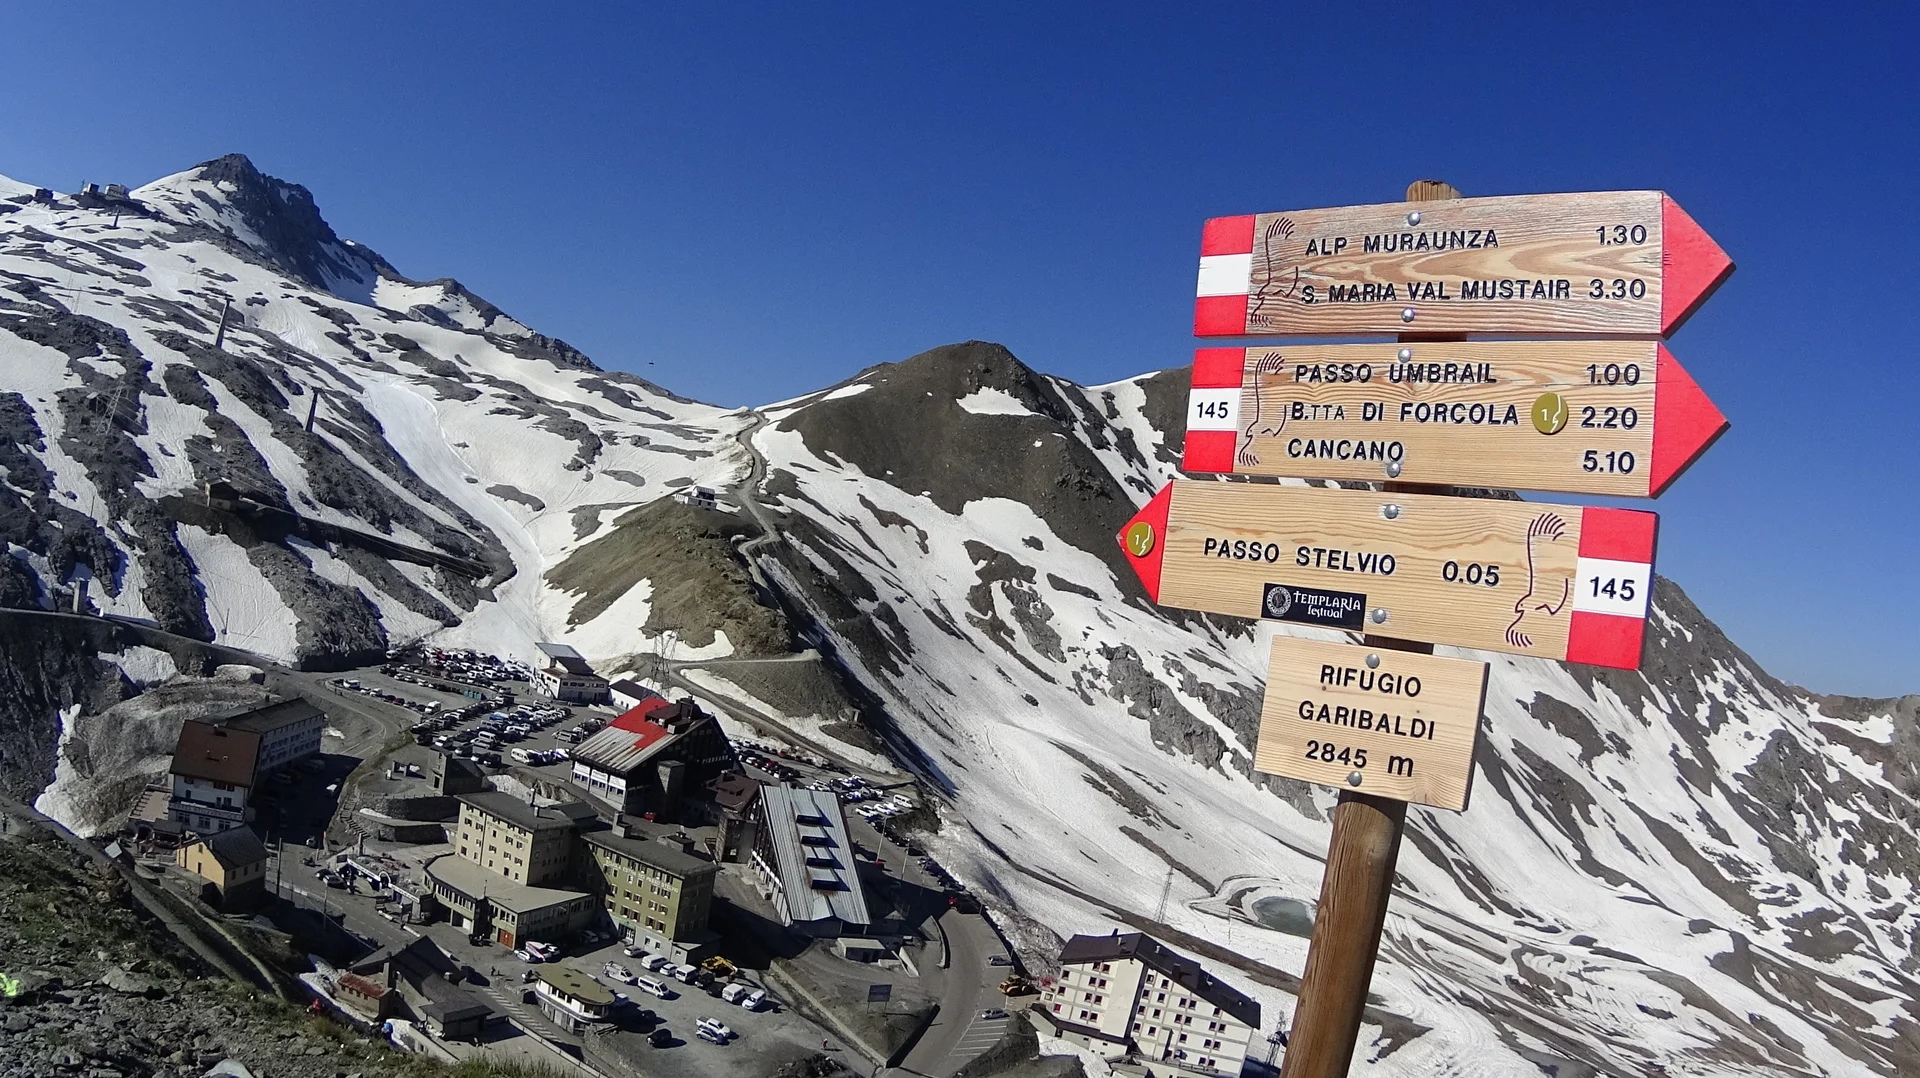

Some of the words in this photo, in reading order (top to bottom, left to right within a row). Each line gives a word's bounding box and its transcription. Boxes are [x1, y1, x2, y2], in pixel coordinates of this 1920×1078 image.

[1305, 237, 1347, 256] ALP
[1364, 229, 1498, 253] MURAUNZA
[1596, 225, 1646, 244] 1.30
[1301, 286, 1323, 304] S.
[1329, 283, 1396, 302] MARIA
[1408, 282, 1450, 302] VAL
[1462, 280, 1570, 299] MUSTAIR
[1589, 279, 1645, 298] 3.30
[1296, 364, 1371, 383] PASSO
[1390, 364, 1497, 383] UMBRAIL
[1587, 364, 1639, 386] 1.00
[1196, 402, 1229, 419] 145
[1363, 403, 1383, 421] DI
[1400, 403, 1518, 425] FORCOLA
[1581, 406, 1637, 429] 2.20
[1288, 439, 1403, 461] CANCANO
[1583, 450, 1634, 474] 5.10
[1204, 538, 1279, 563] PASSO
[1296, 547, 1395, 575] STELVIO
[1443, 561, 1499, 586] 0.05
[1591, 577, 1634, 600] 145
[1321, 664, 1421, 697] RIFUGIO
[1299, 701, 1434, 740] GARIBALDI
[1306, 740, 1367, 768] 2845
[1388, 756, 1413, 777] m
